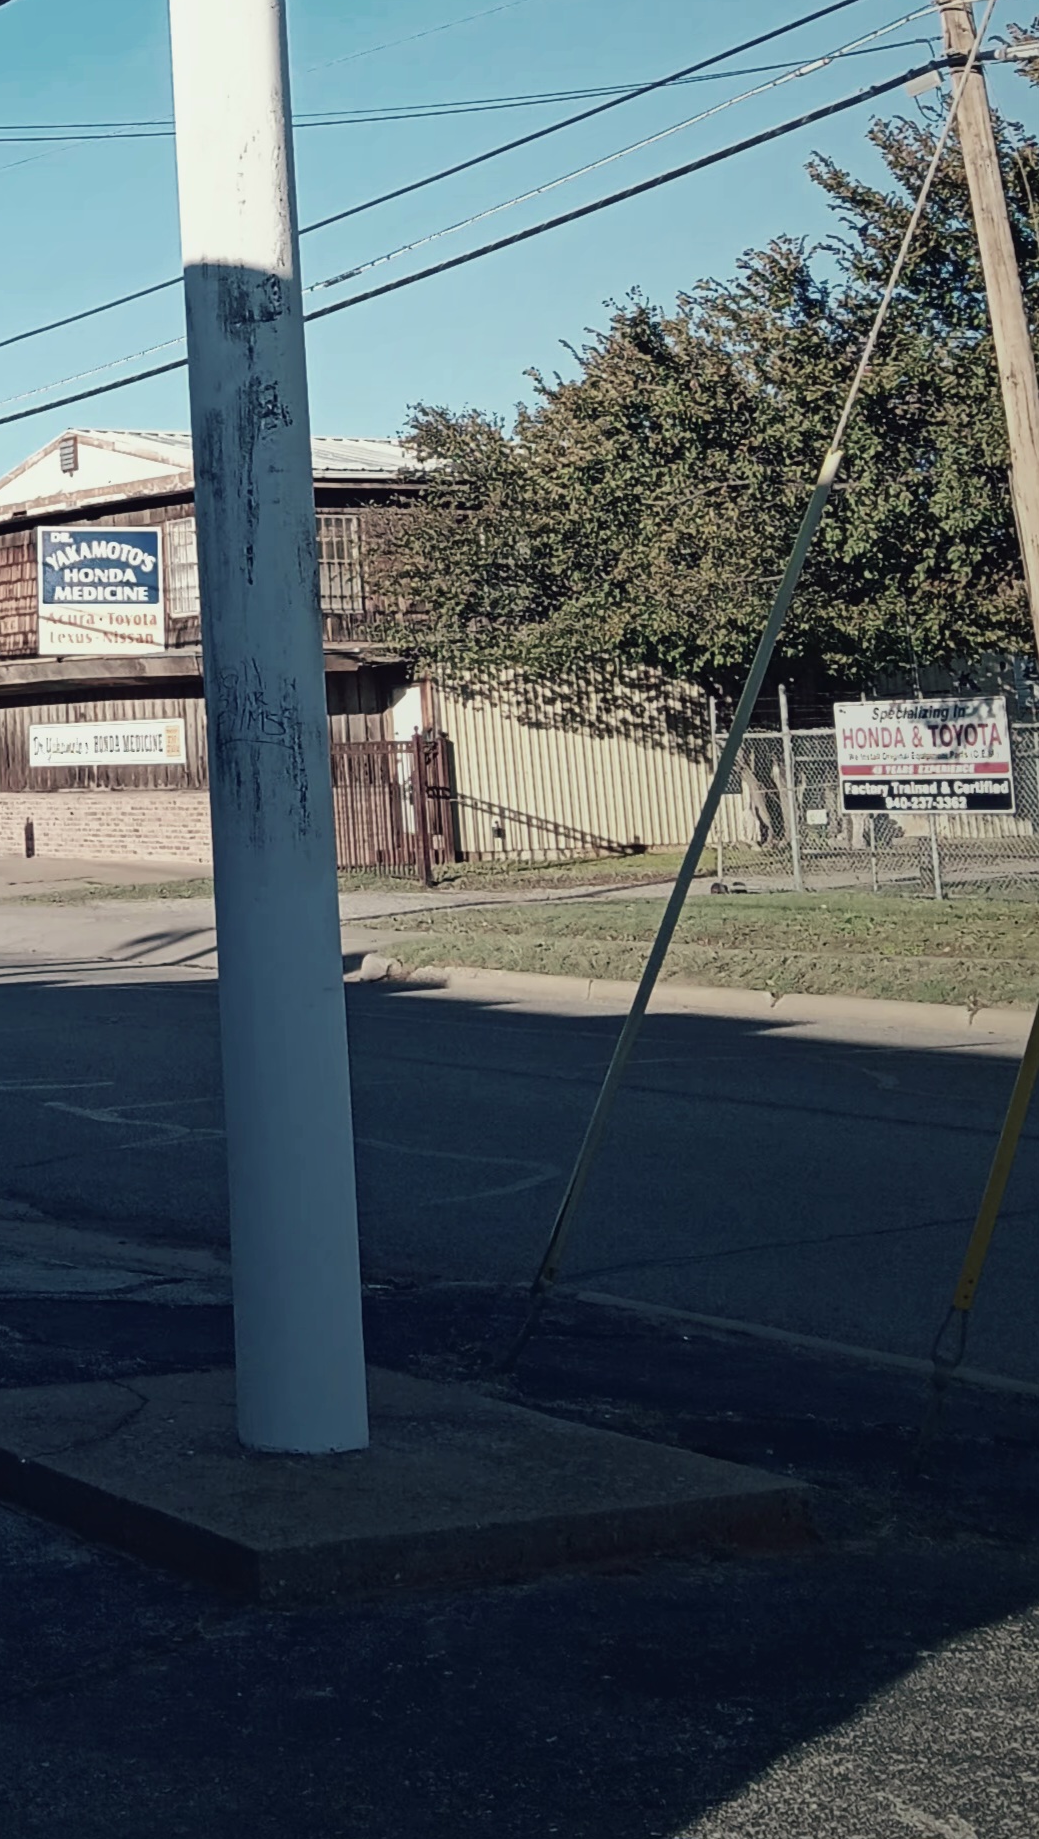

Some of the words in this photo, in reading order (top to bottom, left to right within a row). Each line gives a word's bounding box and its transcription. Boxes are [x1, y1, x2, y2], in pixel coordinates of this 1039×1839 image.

[45, 540, 157, 573] YAKAMOTO'S
[64, 568, 137, 583] HONDA
[54, 586, 149, 601] MEDICINE
[48, 612, 95, 625] Acura
[107, 612, 157, 626] Toyota
[50, 631, 92, 643] Lexus
[103, 631, 154, 644] Nissan
[872, 704, 949, 722] Specializing
[953, 702, 966, 718] In
[122, 733, 163, 753] MEDICINE
[842, 726, 906, 749] HONDA
[912, 725, 923, 748] &
[927, 722, 1003, 747] TOYOTA
[885, 764, 914, 775] YEARS
[918, 763, 975, 775] EXPERIENCE
[844, 783, 889, 797] Factory
[891, 781, 938, 795] Trained
[953, 780, 1009, 795] Certified
